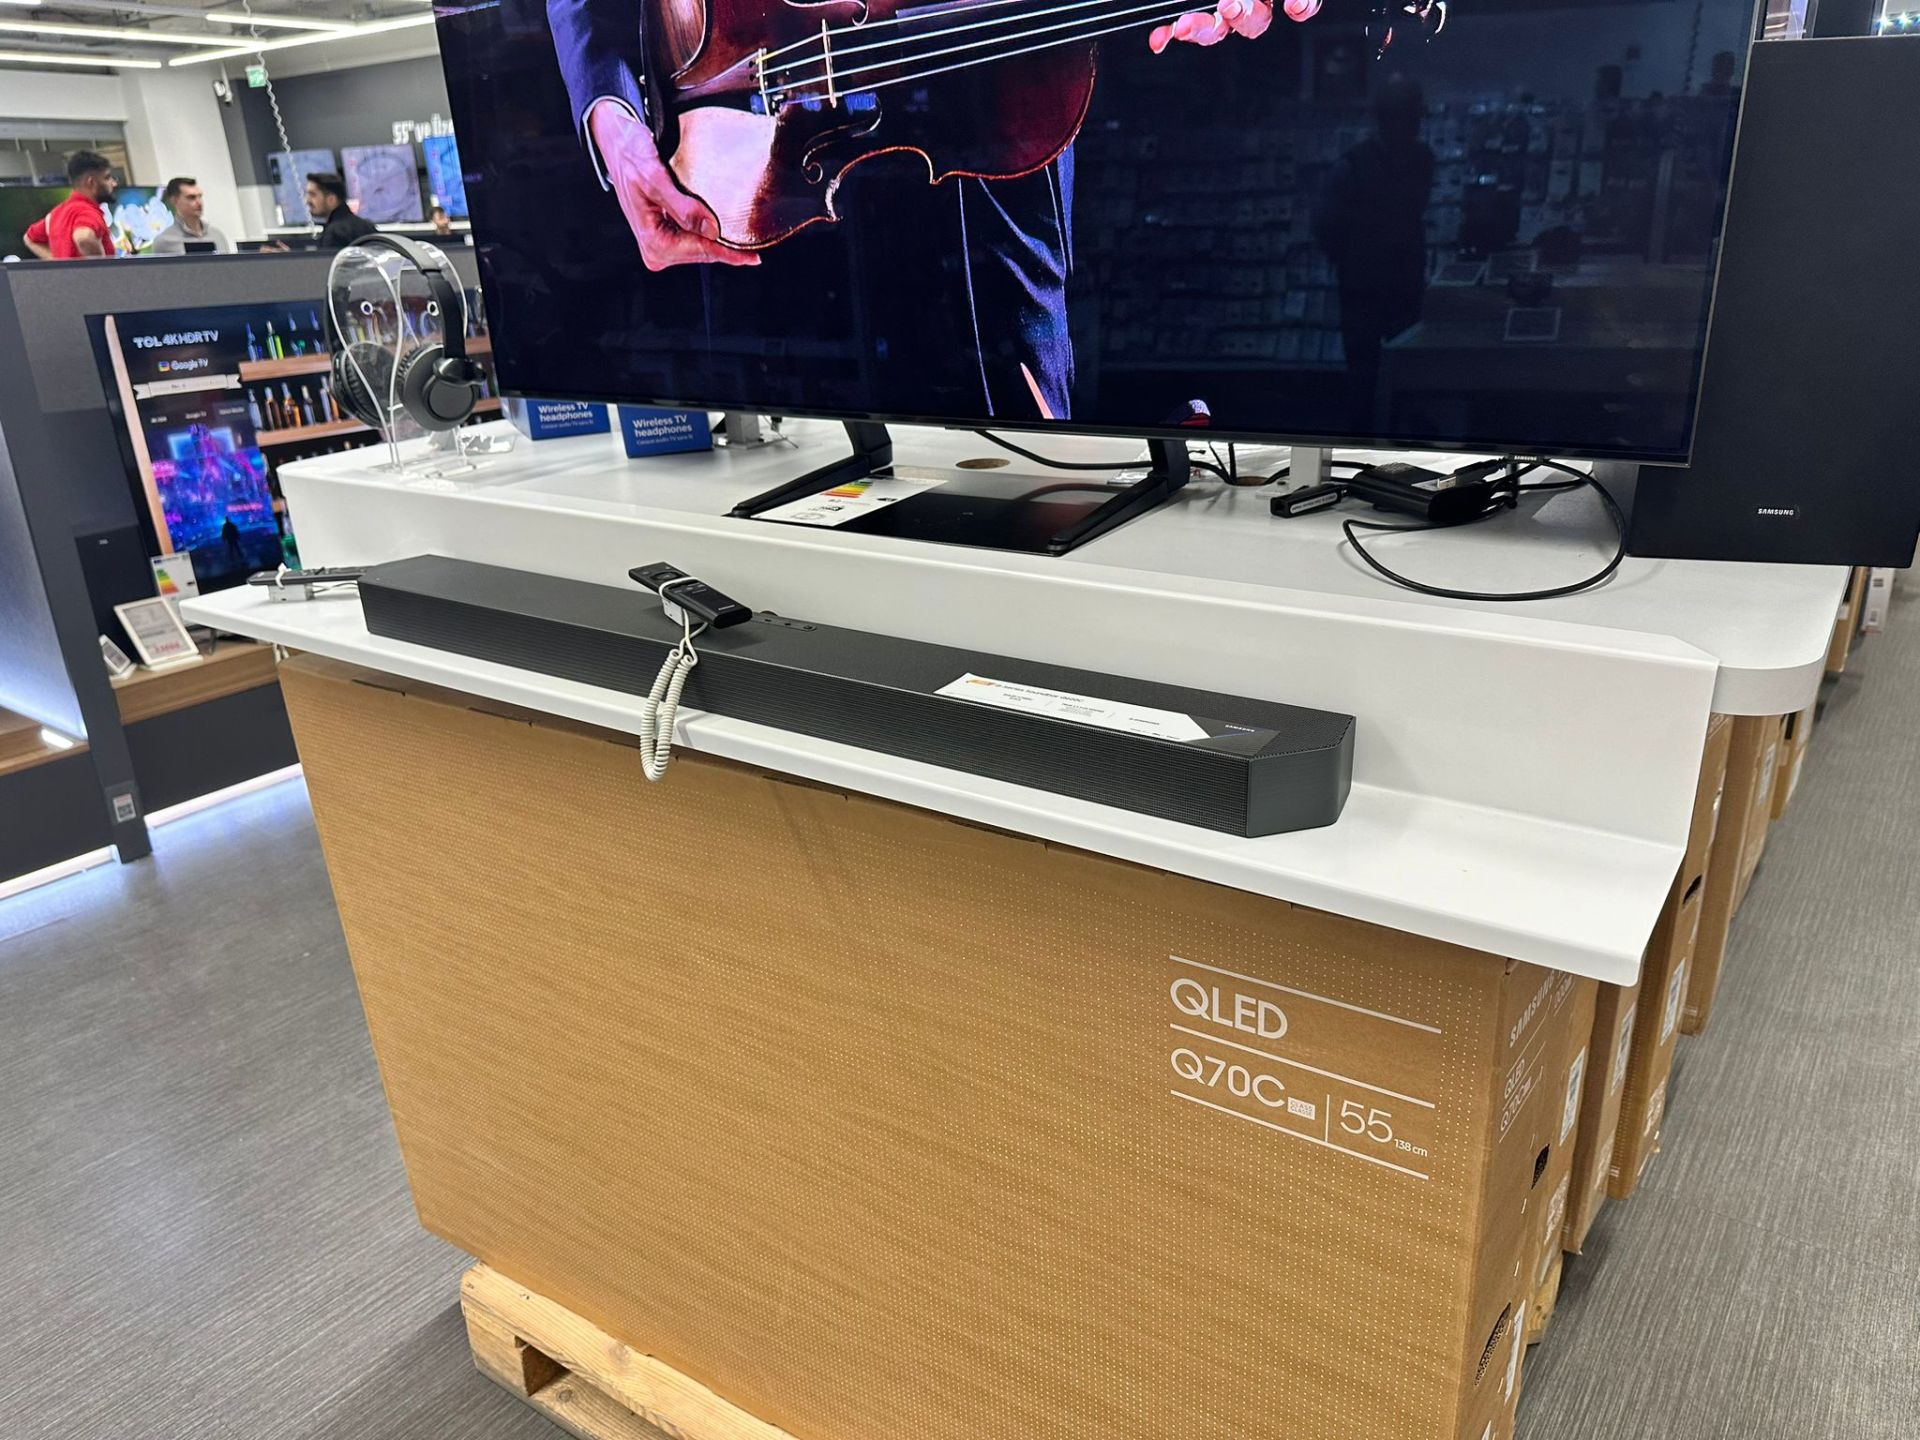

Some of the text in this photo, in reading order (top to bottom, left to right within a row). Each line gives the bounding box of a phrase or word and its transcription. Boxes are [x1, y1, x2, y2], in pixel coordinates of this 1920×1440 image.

[171, 358, 209, 371] Google TV
[538, 401, 588, 414] Wireless TV
[540, 410, 593, 422] headphones
[632, 414, 687, 429] Wireless TV
[634, 424, 693, 438] headphones
[1757, 508, 1794, 516] SAMSUNG
[1169, 978, 1289, 1040] QLED
[1509, 969, 1555, 1049] SAMSUNG
[1170, 1047, 1286, 1107] Q70C
[1504, 1058, 1525, 1099] QLED
[1500, 1085, 1525, 1131] Q70C
[1340, 1099, 1428, 1157] 55 138 cm
